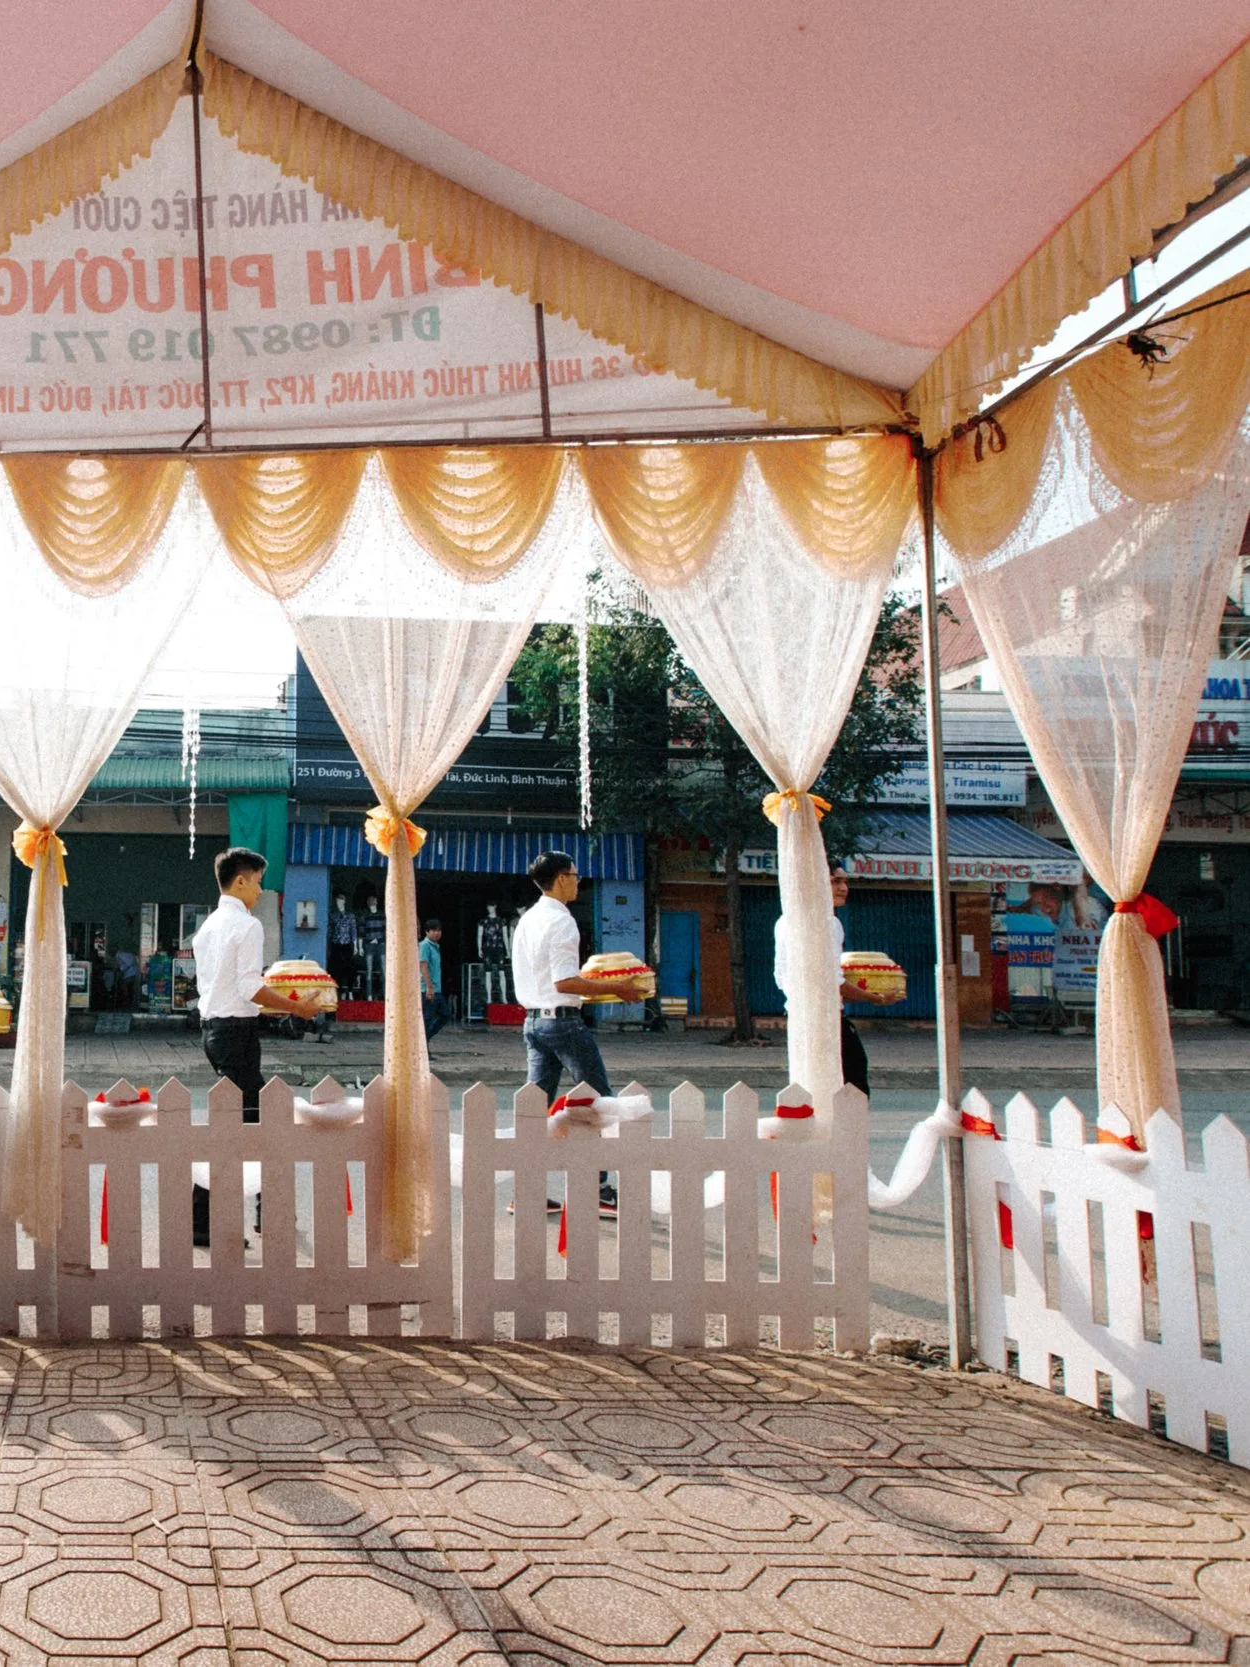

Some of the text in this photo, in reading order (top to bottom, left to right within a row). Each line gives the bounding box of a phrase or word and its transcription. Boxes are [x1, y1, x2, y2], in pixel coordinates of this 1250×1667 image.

[298, 767, 315, 777] 251
[464, 771, 483, 783] Đức
[486, 773, 510, 785] Linh,
[537, 774, 567, 788] Thuận
[953, 777, 1001, 789] Tiramisu
[854, 858, 923, 877] MINH
[928, 860, 1032, 879] HƯƠNG
